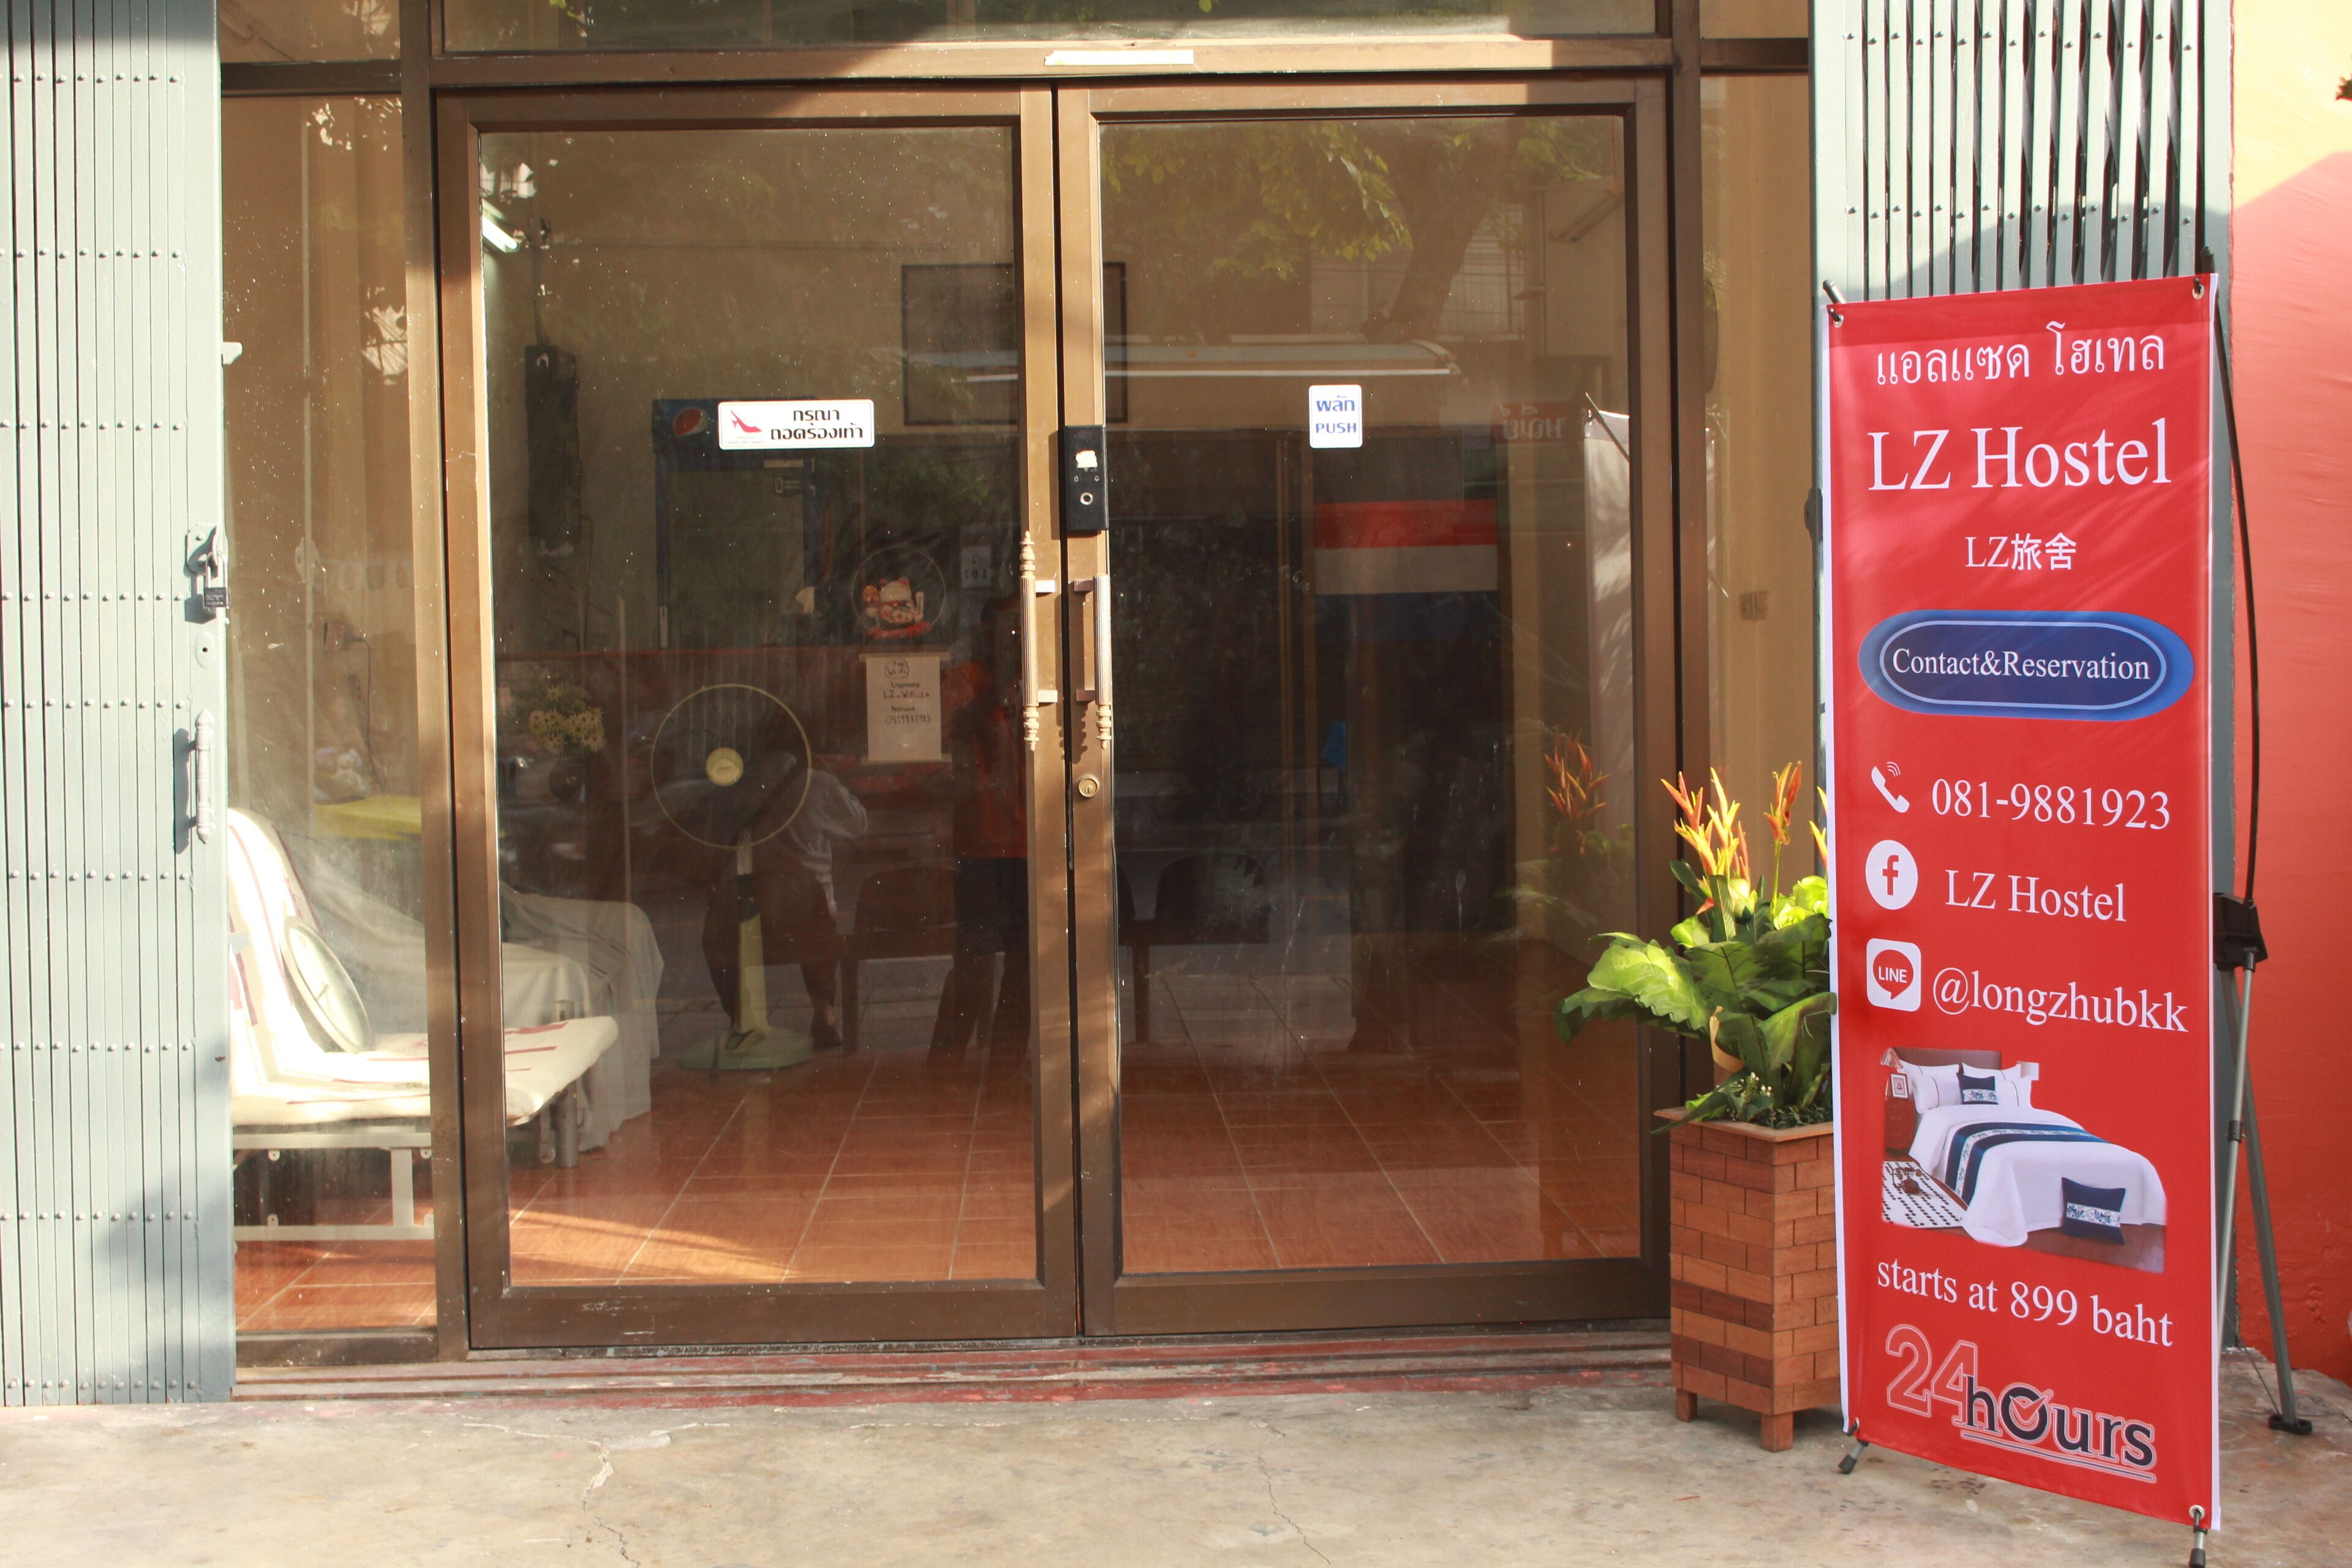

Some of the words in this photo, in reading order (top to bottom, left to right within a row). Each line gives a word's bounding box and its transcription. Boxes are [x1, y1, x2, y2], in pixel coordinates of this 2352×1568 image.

[1877, 343, 2030, 385] แอลแซด
[2046, 321, 2165, 375] โฮเทล
[793, 409, 840, 425] กรุณา
[1315, 423, 1357, 434] PUSH
[1868, 429, 1951, 491] LZ
[1970, 417, 2171, 488] Hostel
[1965, 532, 2077, 570] LZ旅舍
[1893, 648, 2150, 680] Contact&Reservation
[1932, 778, 2170, 830] 081-9881923
[1945, 869, 1996, 910] LZ
[2008, 875, 2127, 922] Hostel
[1878, 965, 1908, 984] LINE
[1932, 967, 2188, 1033] @longzhubkk
[1877, 1259, 1958, 1303] starts
[1969, 1281, 1998, 1312] at
[2011, 1281, 2078, 1326] 899
[2090, 1295, 2173, 1347] baht
